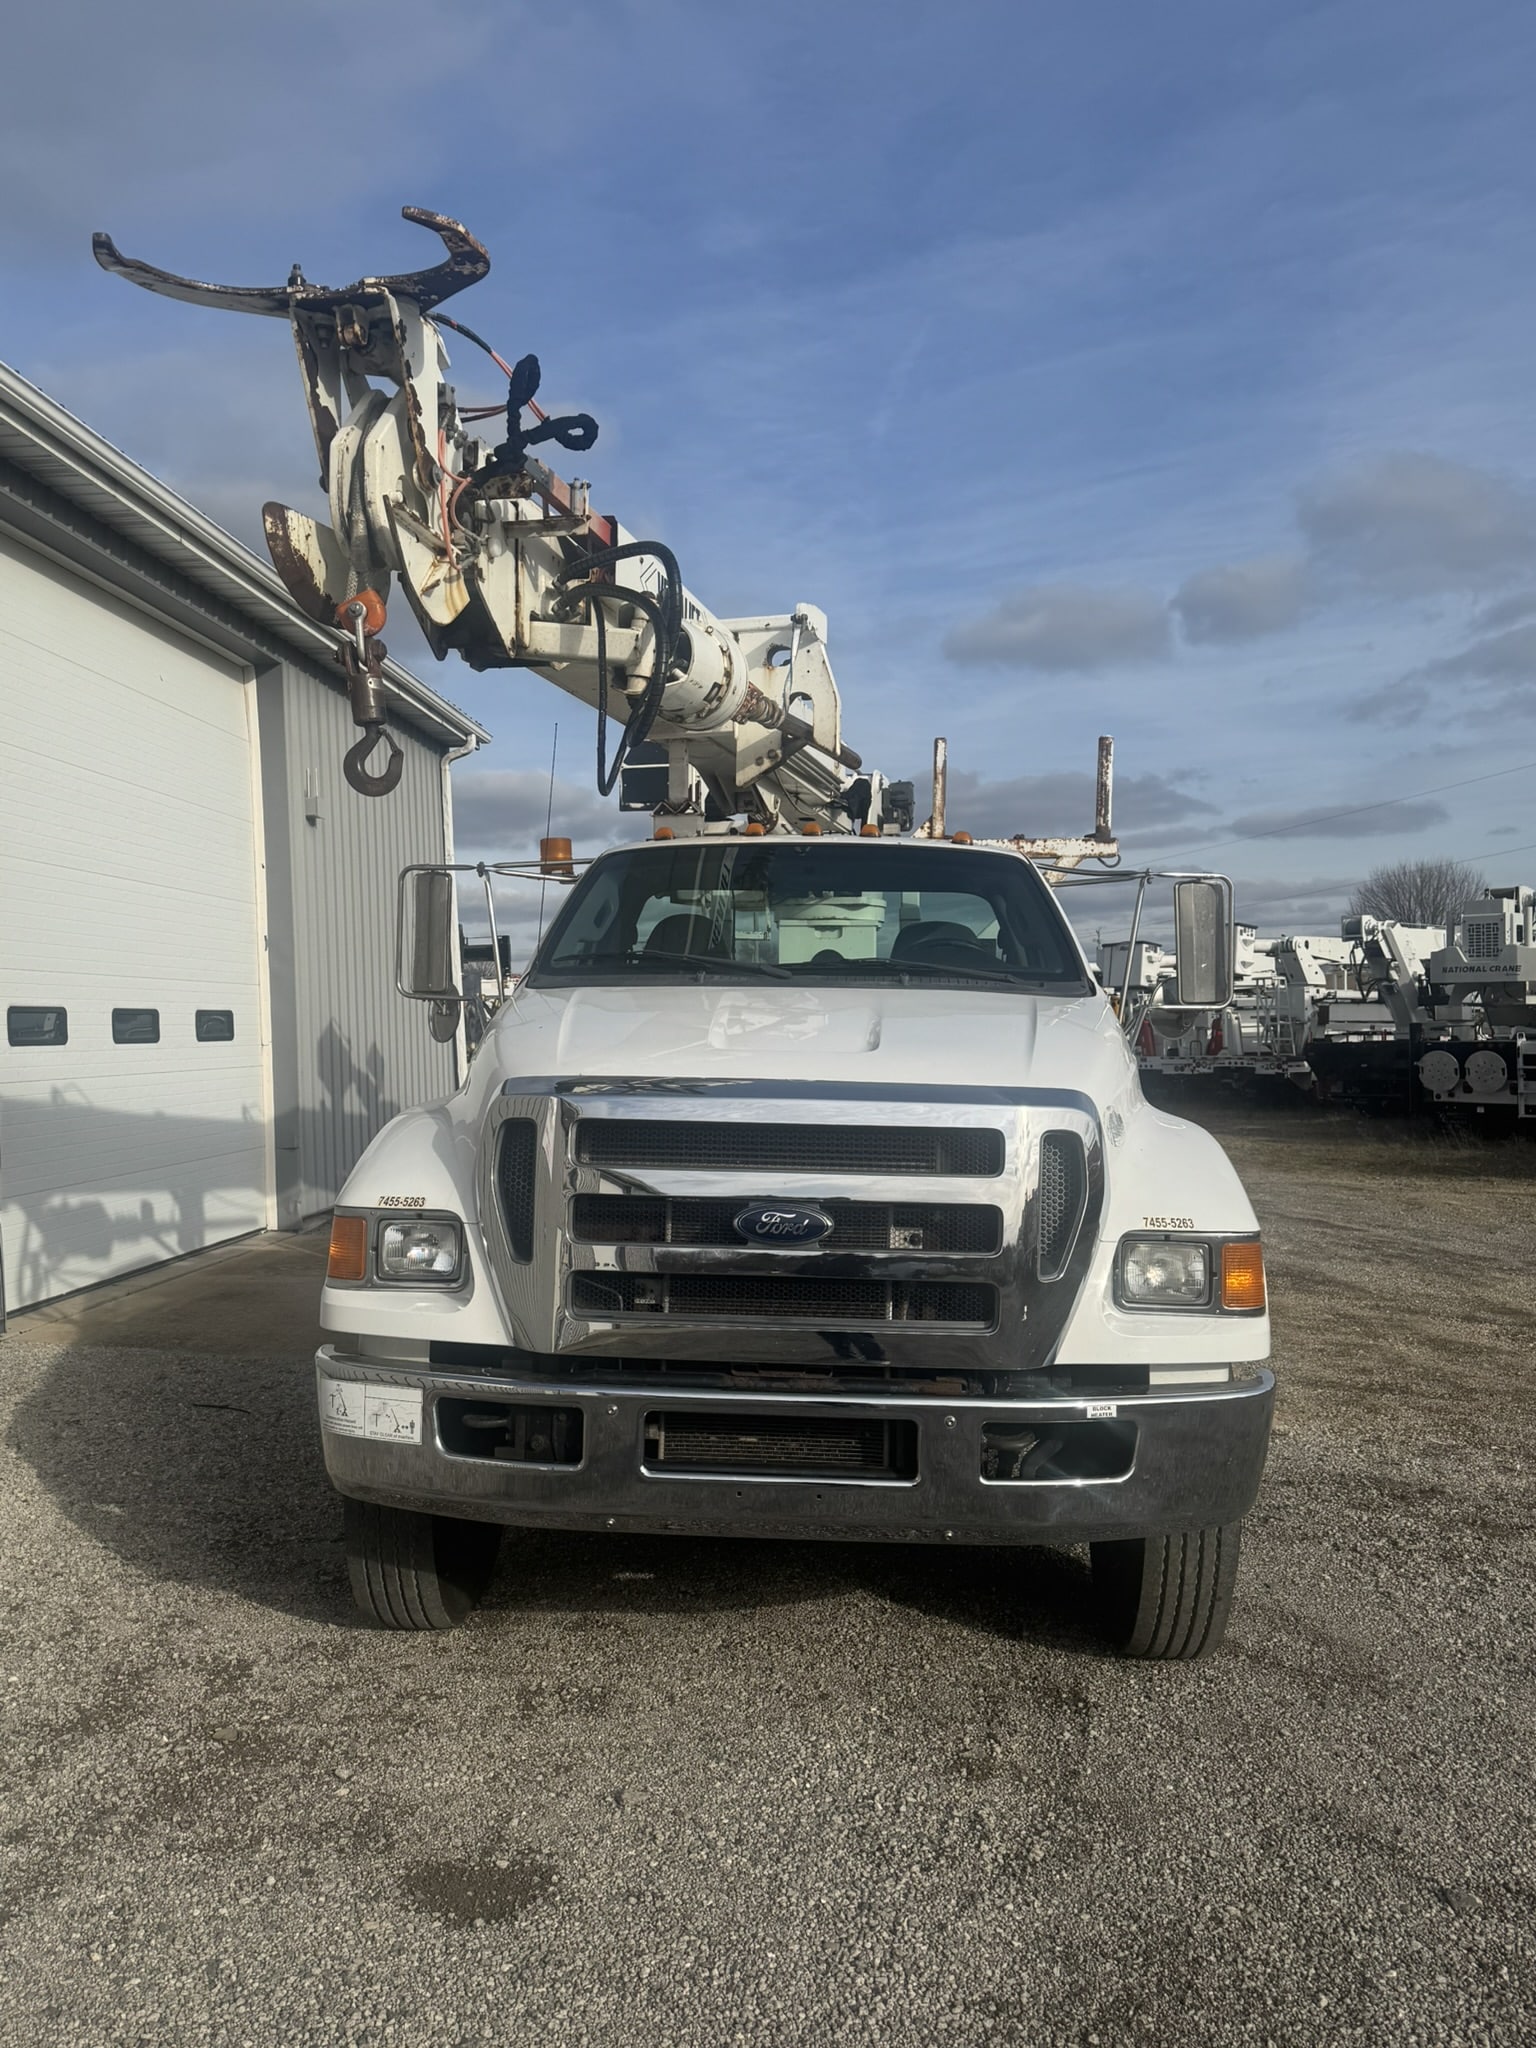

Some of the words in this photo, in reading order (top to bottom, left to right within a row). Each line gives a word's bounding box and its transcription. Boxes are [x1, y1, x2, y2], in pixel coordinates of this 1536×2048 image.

[1441, 965, 1487, 974] NATIONAL
[1489, 964, 1522, 973] CRANE
[378, 1196, 426, 1208] 7455-5263
[755, 1211, 810, 1236] Ford
[1142, 1216, 1195, 1229] 7455-5263
